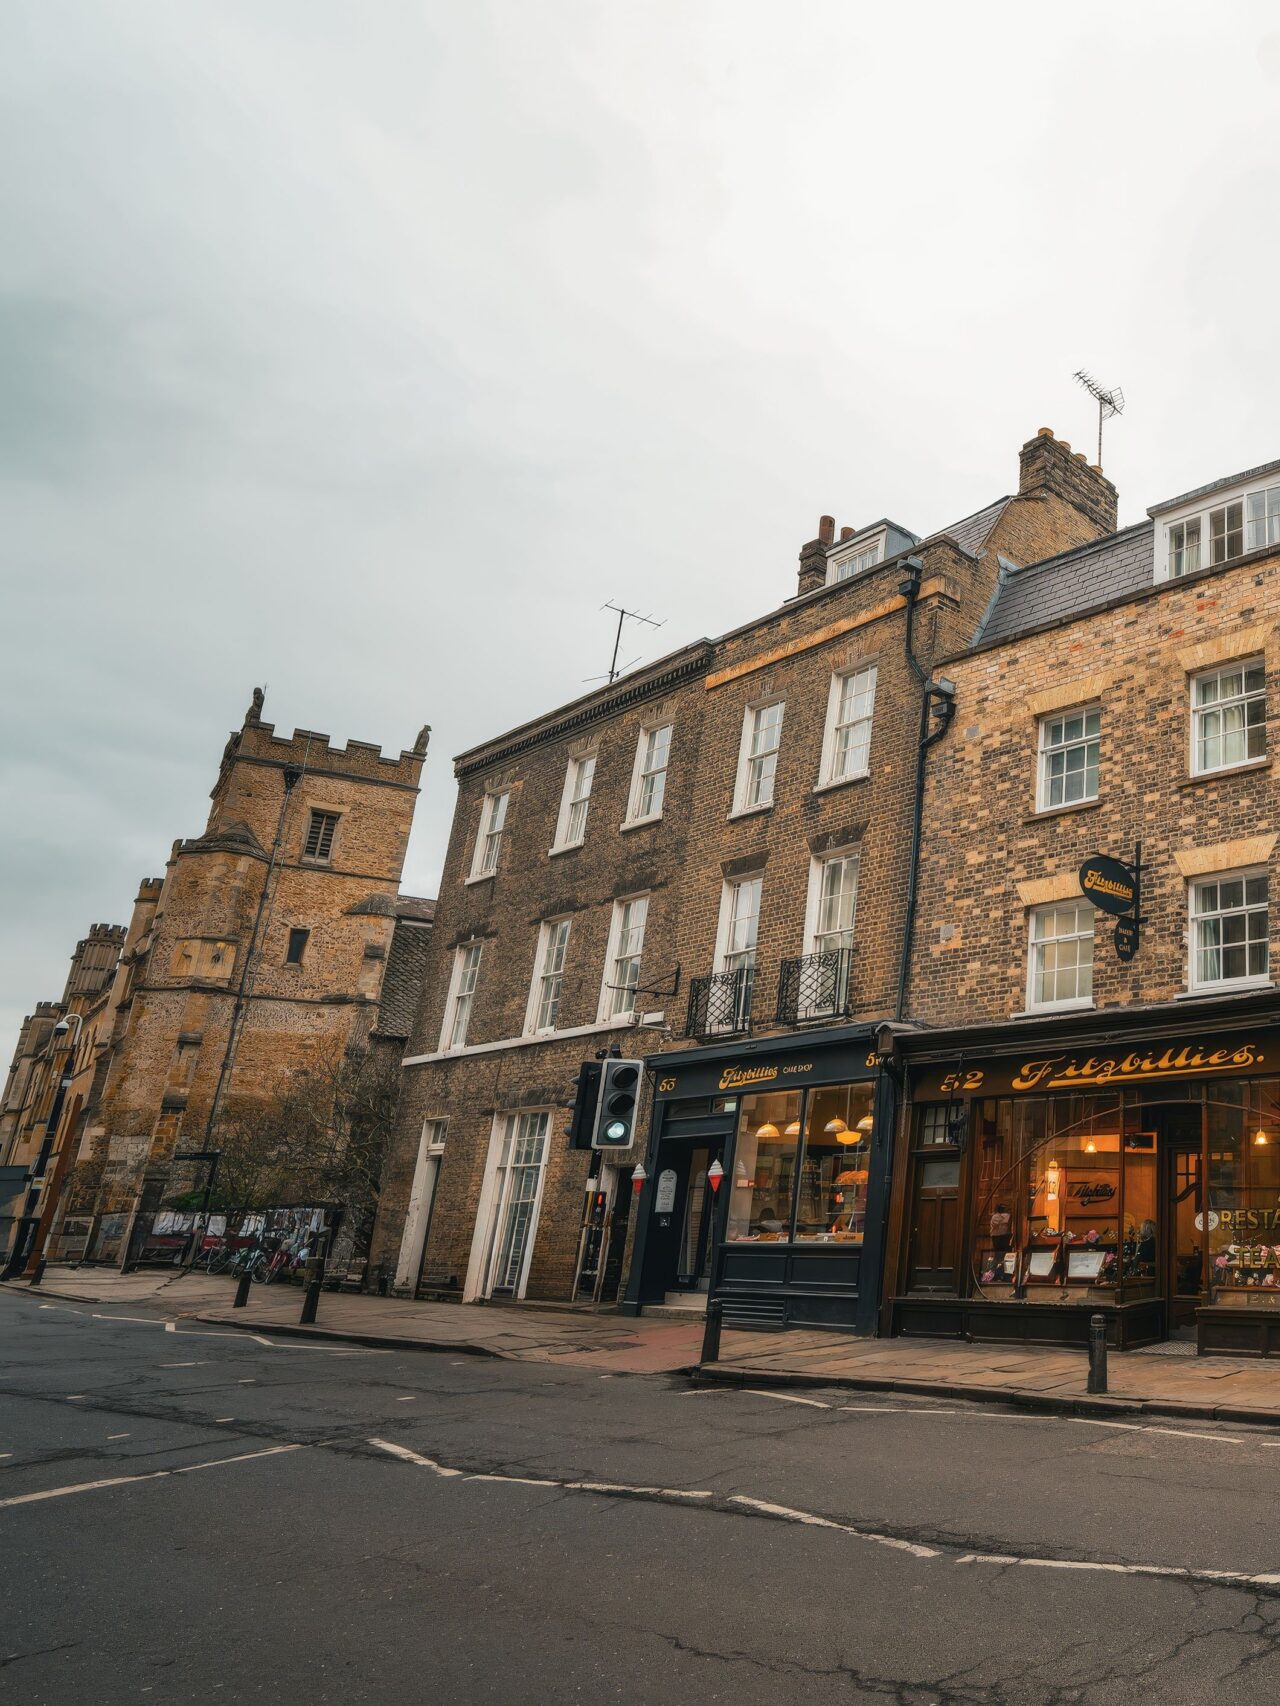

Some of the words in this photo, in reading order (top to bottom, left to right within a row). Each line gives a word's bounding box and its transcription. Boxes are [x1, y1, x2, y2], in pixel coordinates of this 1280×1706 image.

[718, 1064, 779, 1090] Fitzbillies
[940, 1070, 984, 1092] 52
[1234, 1247, 1280, 1270] TEA
